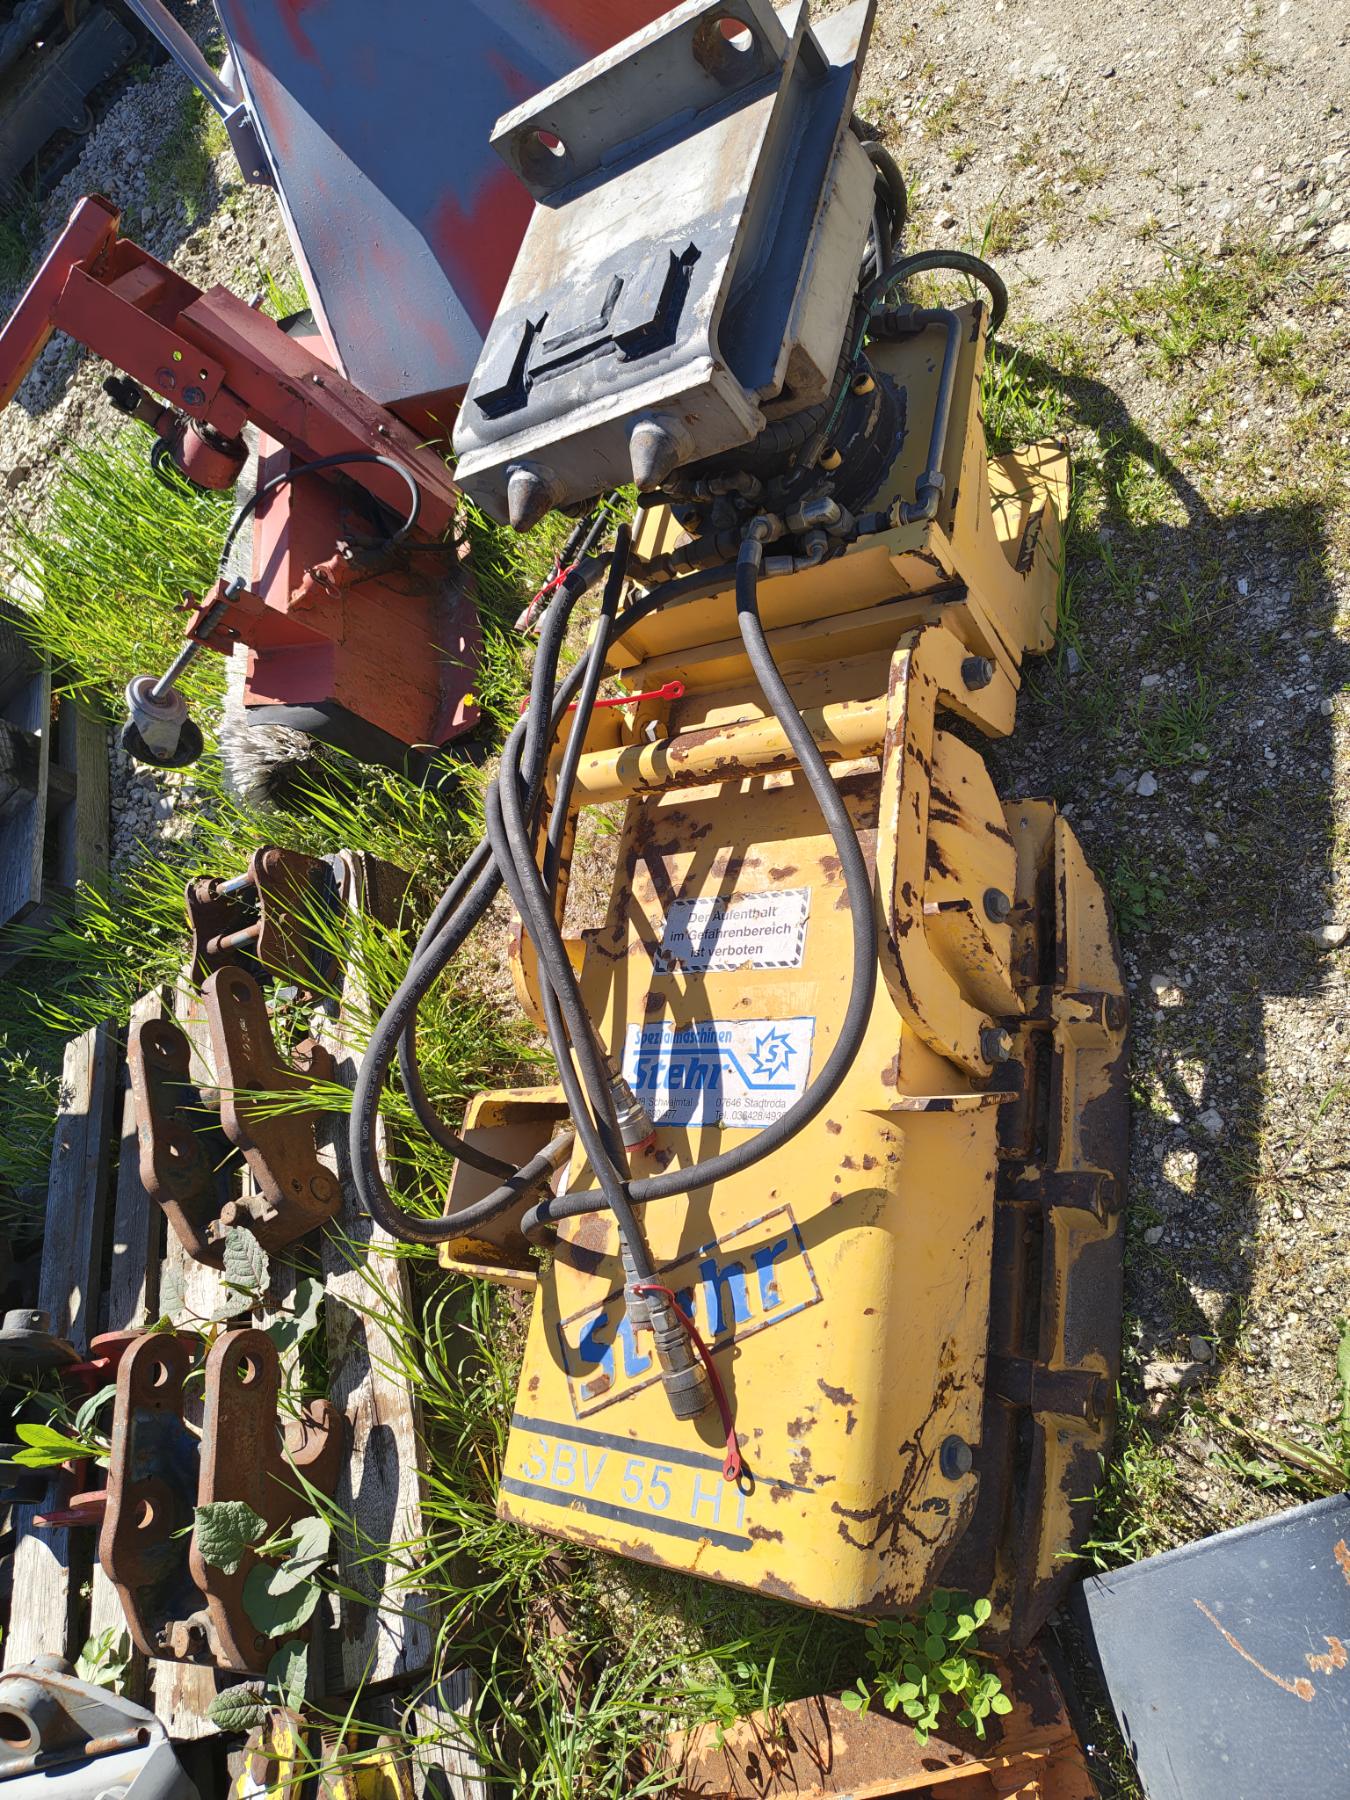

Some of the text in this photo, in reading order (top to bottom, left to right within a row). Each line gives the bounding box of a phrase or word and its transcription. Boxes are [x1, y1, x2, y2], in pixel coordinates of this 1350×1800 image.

[688, 906, 777, 924] Der Aufenthalt
[670, 923, 792, 942] im Gefahrenbereich
[690, 944, 763, 958] ist verboten
[634, 1027, 733, 1047] Spezialmaschinen
[630, 1056, 730, 1090] Stehr
[715, 1097, 741, 1108] 07646
[579, 1238, 788, 1401] Sthr
[522, 1438, 608, 1493] SBV
[620, 1458, 673, 1511] 55
